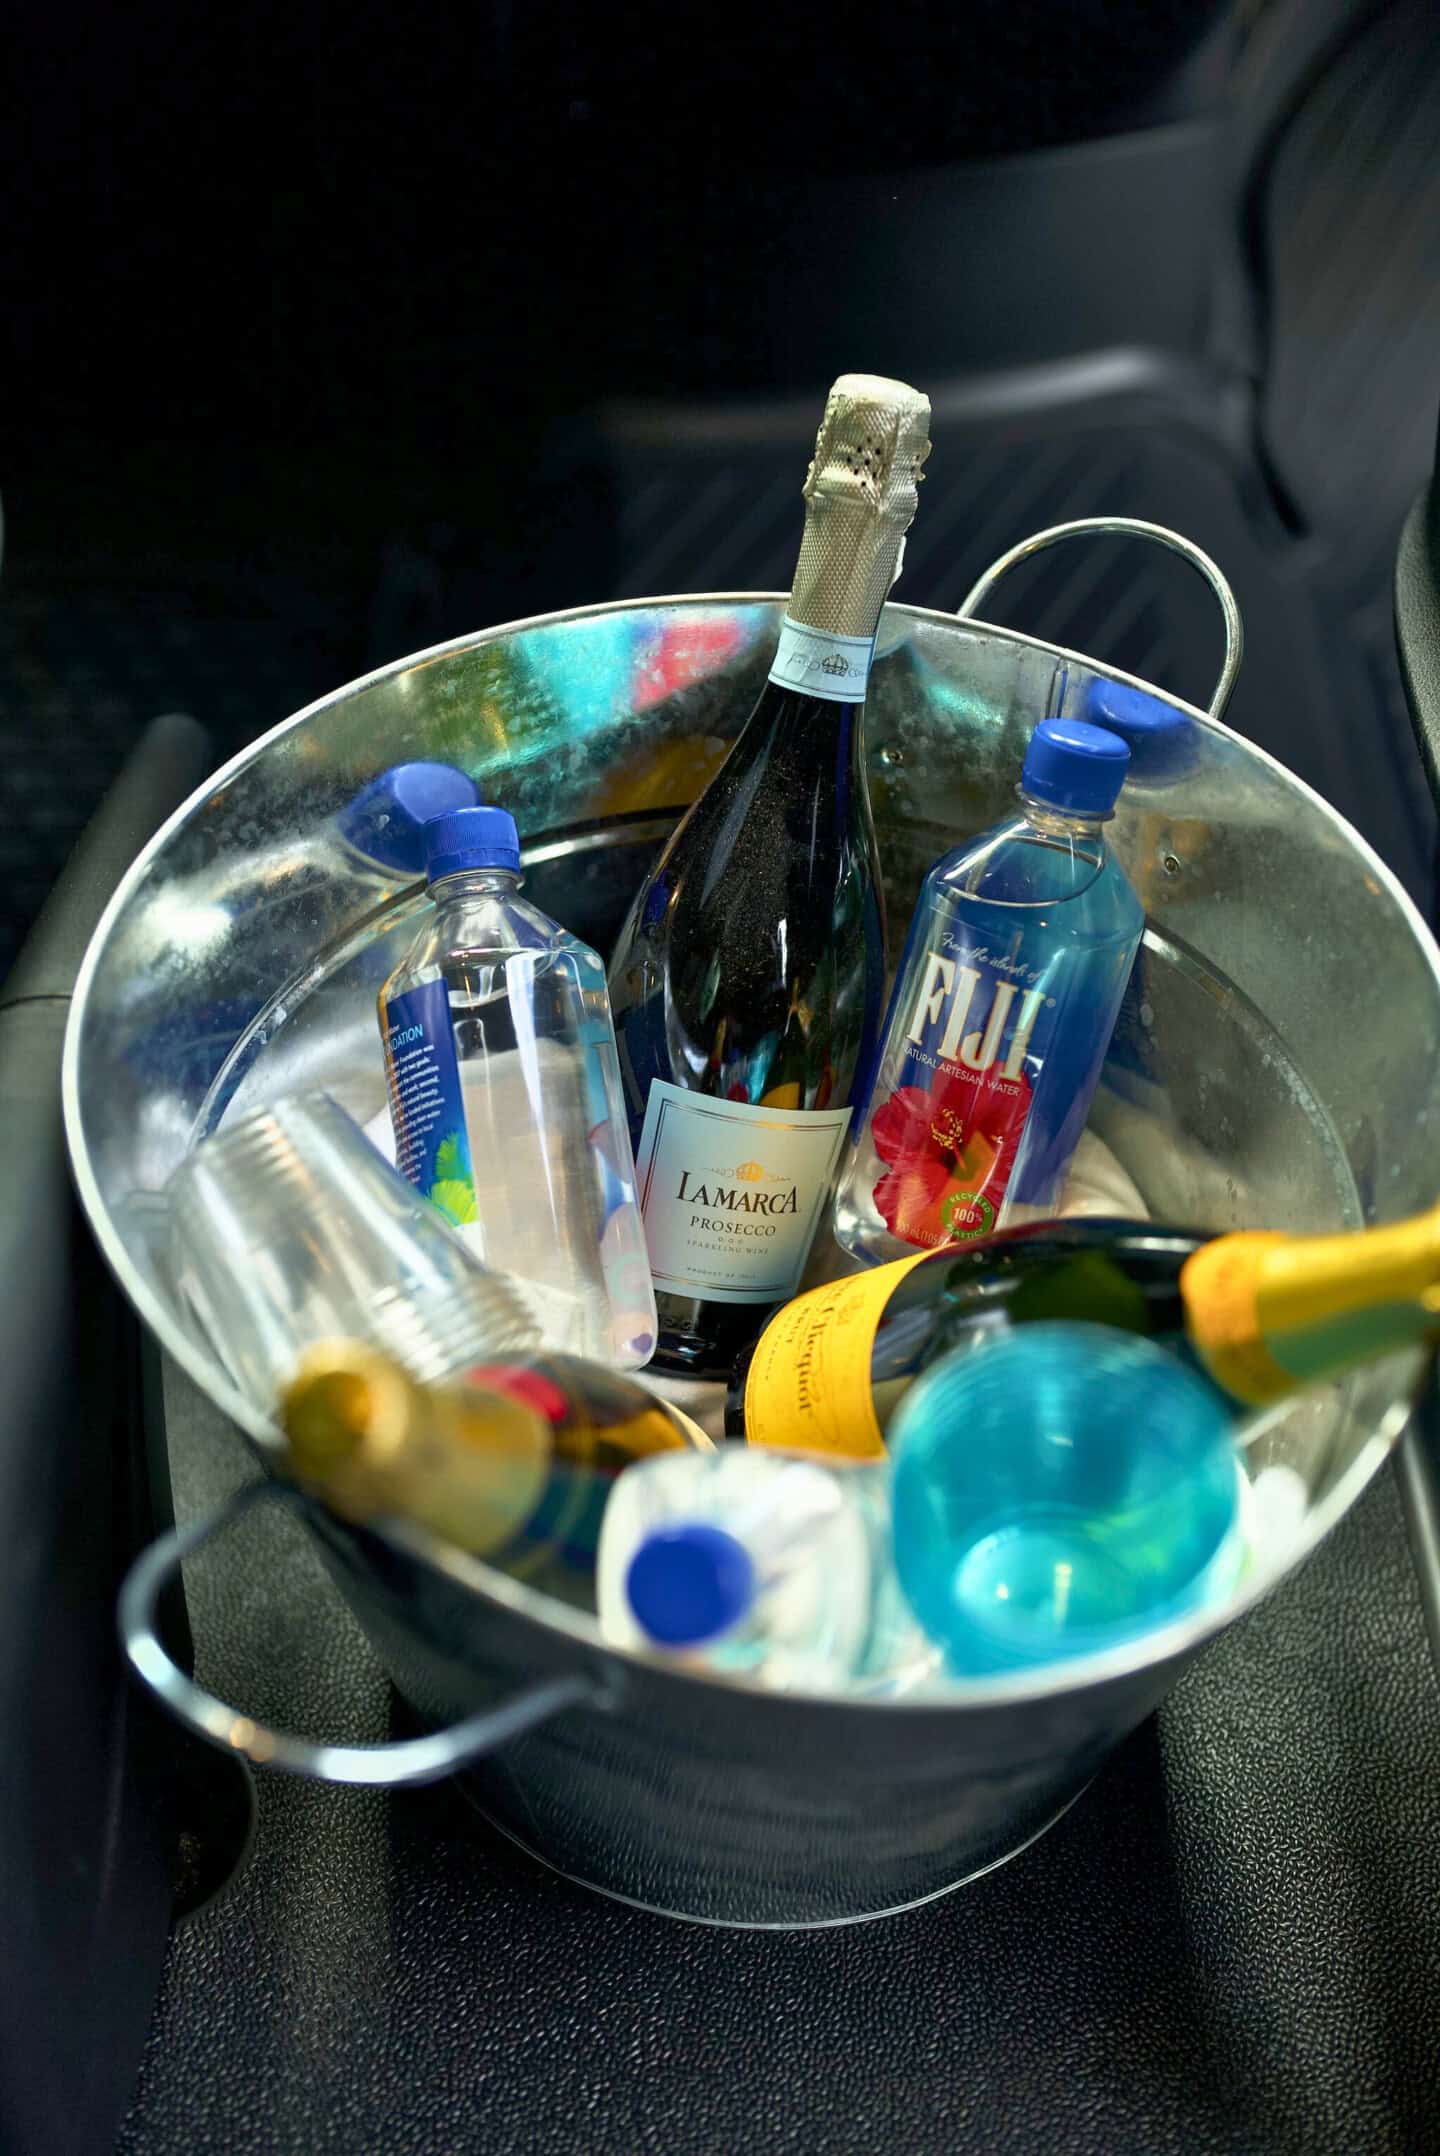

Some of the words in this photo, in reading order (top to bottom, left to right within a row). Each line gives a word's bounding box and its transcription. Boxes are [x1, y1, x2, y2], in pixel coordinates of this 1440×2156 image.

[906, 951, 1046, 1082] FIJI
[903, 1046, 938, 1070] NATURAL
[938, 1063, 985, 1087] ARTESIAN
[986, 1079, 1021, 1097] WATER
[689, 1214, 777, 1238] PROSECCO
